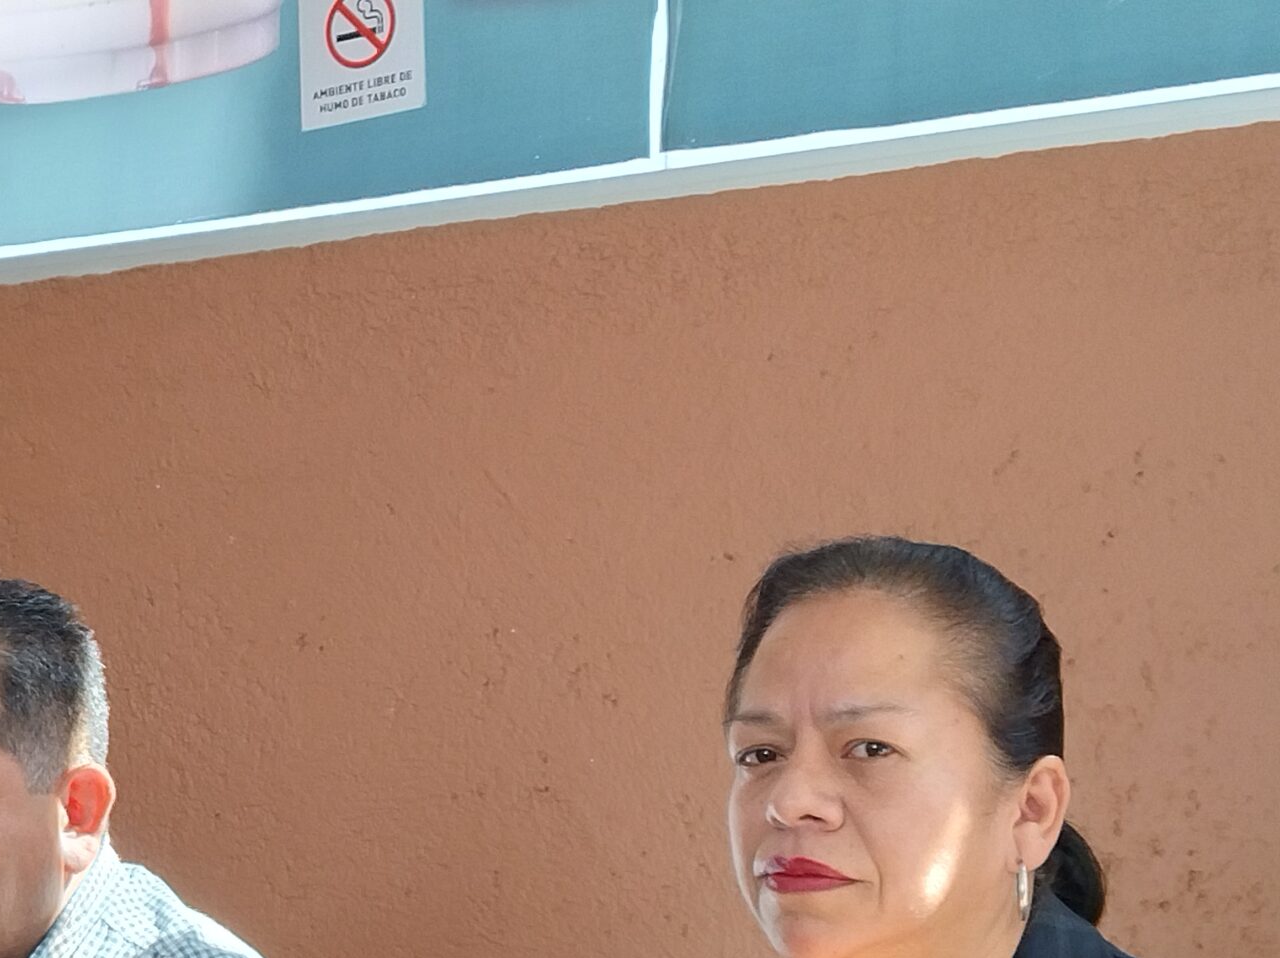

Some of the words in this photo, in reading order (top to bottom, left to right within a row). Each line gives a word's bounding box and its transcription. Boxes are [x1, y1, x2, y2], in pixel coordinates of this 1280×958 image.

[313, 80, 364, 100] AMBIENTE
[367, 73, 396, 89] LIBRE
[399, 70, 413, 81] DE
[319, 99, 349, 113] HUMO
[351, 95, 364, 107] DE
[367, 87, 407, 104] TABACO
